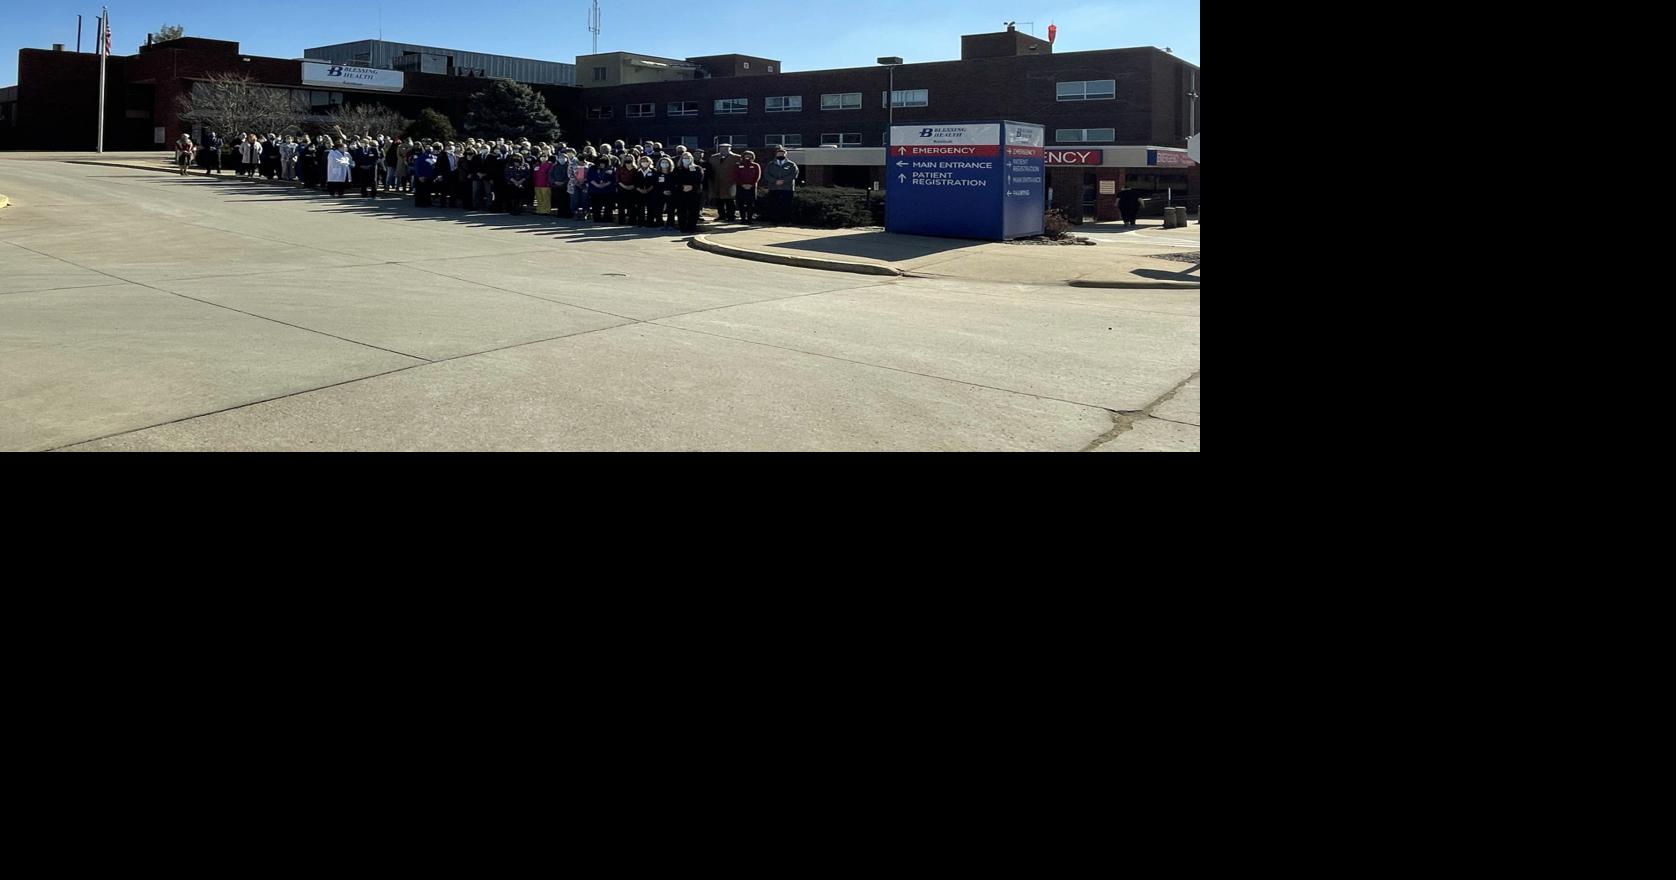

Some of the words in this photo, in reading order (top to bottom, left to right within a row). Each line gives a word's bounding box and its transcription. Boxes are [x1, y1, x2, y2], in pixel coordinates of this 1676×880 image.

[344, 66, 378, 75] BLESSING
[343, 72, 374, 80] HEALTH
[912, 161, 937, 169] MAIN
[912, 178, 987, 187] REGISTRATION
